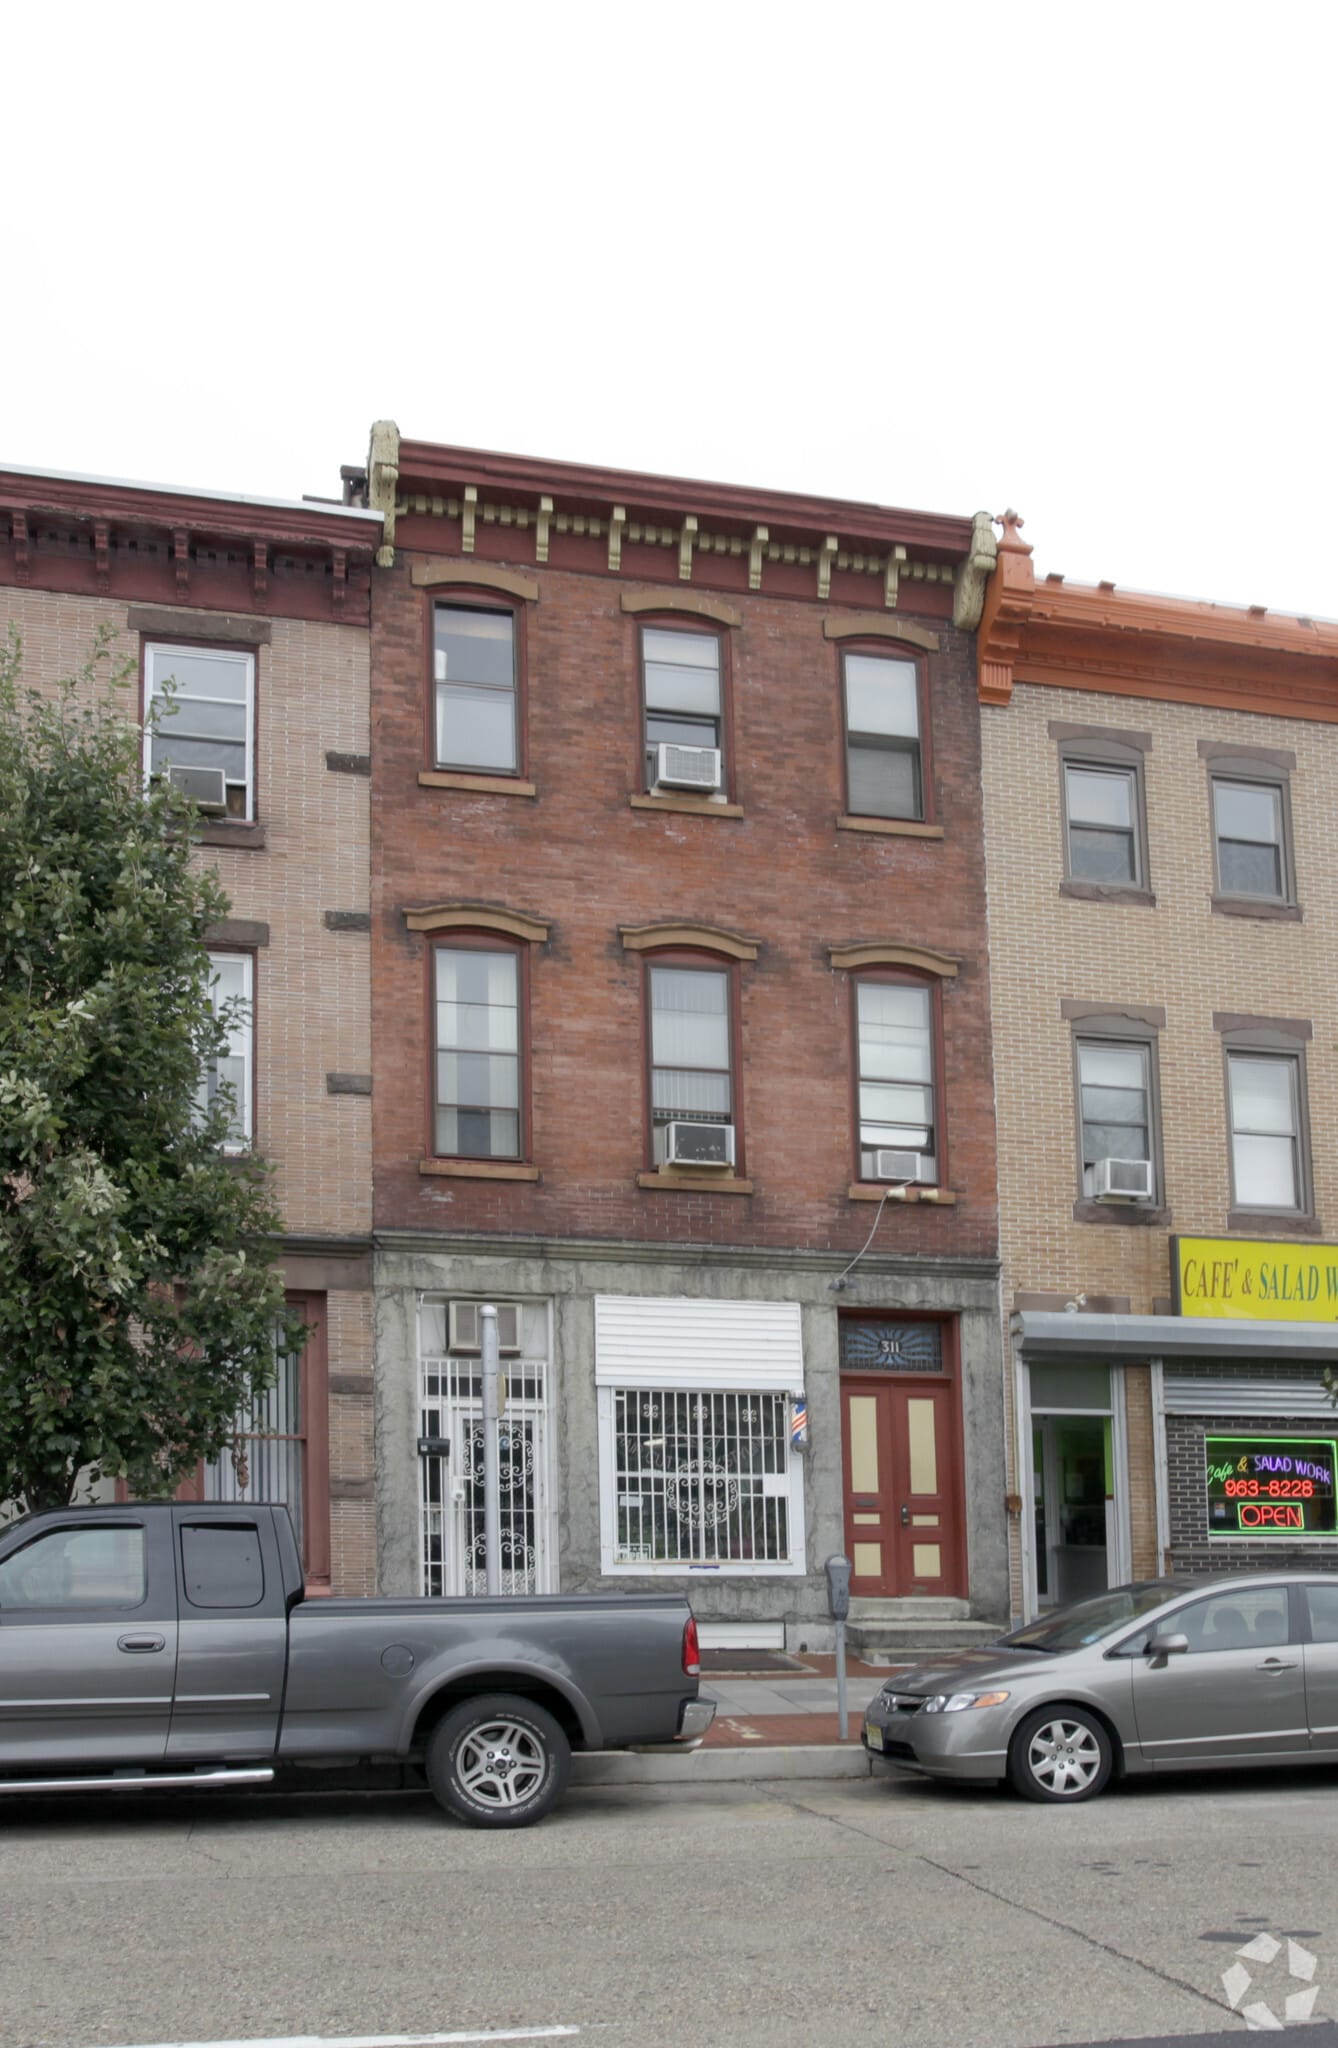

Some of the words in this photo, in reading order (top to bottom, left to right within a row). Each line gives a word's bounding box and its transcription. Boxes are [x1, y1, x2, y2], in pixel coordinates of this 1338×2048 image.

[1241, 1268, 1252, 1295] &
[1258, 1262, 1320, 1302] SALAD
[881, 1340, 900, 1353] 311
[1206, 1462, 1234, 1486] Cafe
[1237, 1456, 1248, 1473] &
[1254, 1455, 1292, 1472] SALAD
[1295, 1459, 1331, 1485] WORK
[1225, 1479, 1314, 1498] 963-8228
[1241, 1505, 1302, 1527] OPEN
